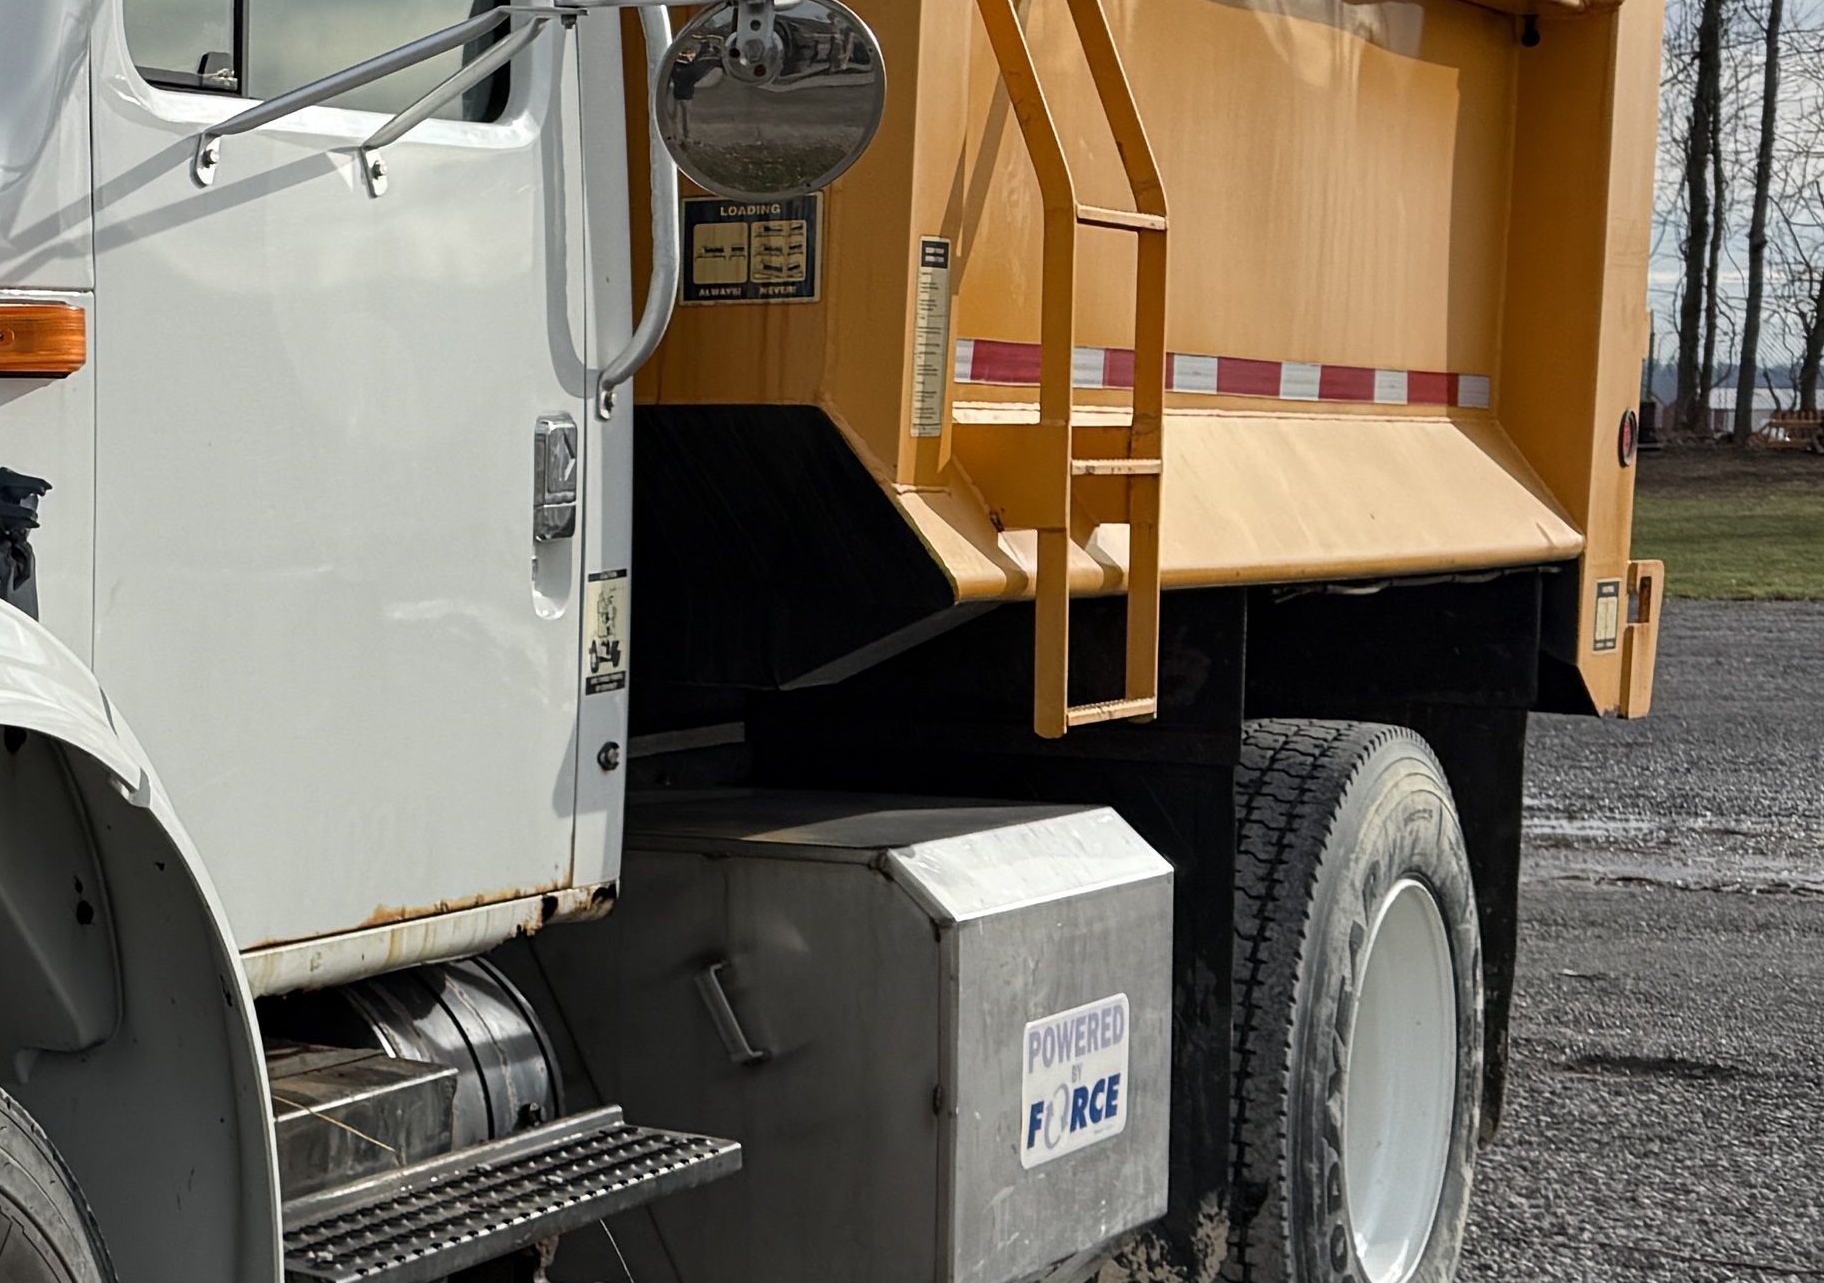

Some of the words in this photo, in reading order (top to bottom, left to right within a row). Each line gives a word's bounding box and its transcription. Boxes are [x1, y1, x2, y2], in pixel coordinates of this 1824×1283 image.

[720, 203, 781, 217] LOADING
[1027, 1004, 1125, 1074] POWERED
[1071, 1063, 1084, 1083] BY
[1026, 1072, 1122, 1150] FORCE
